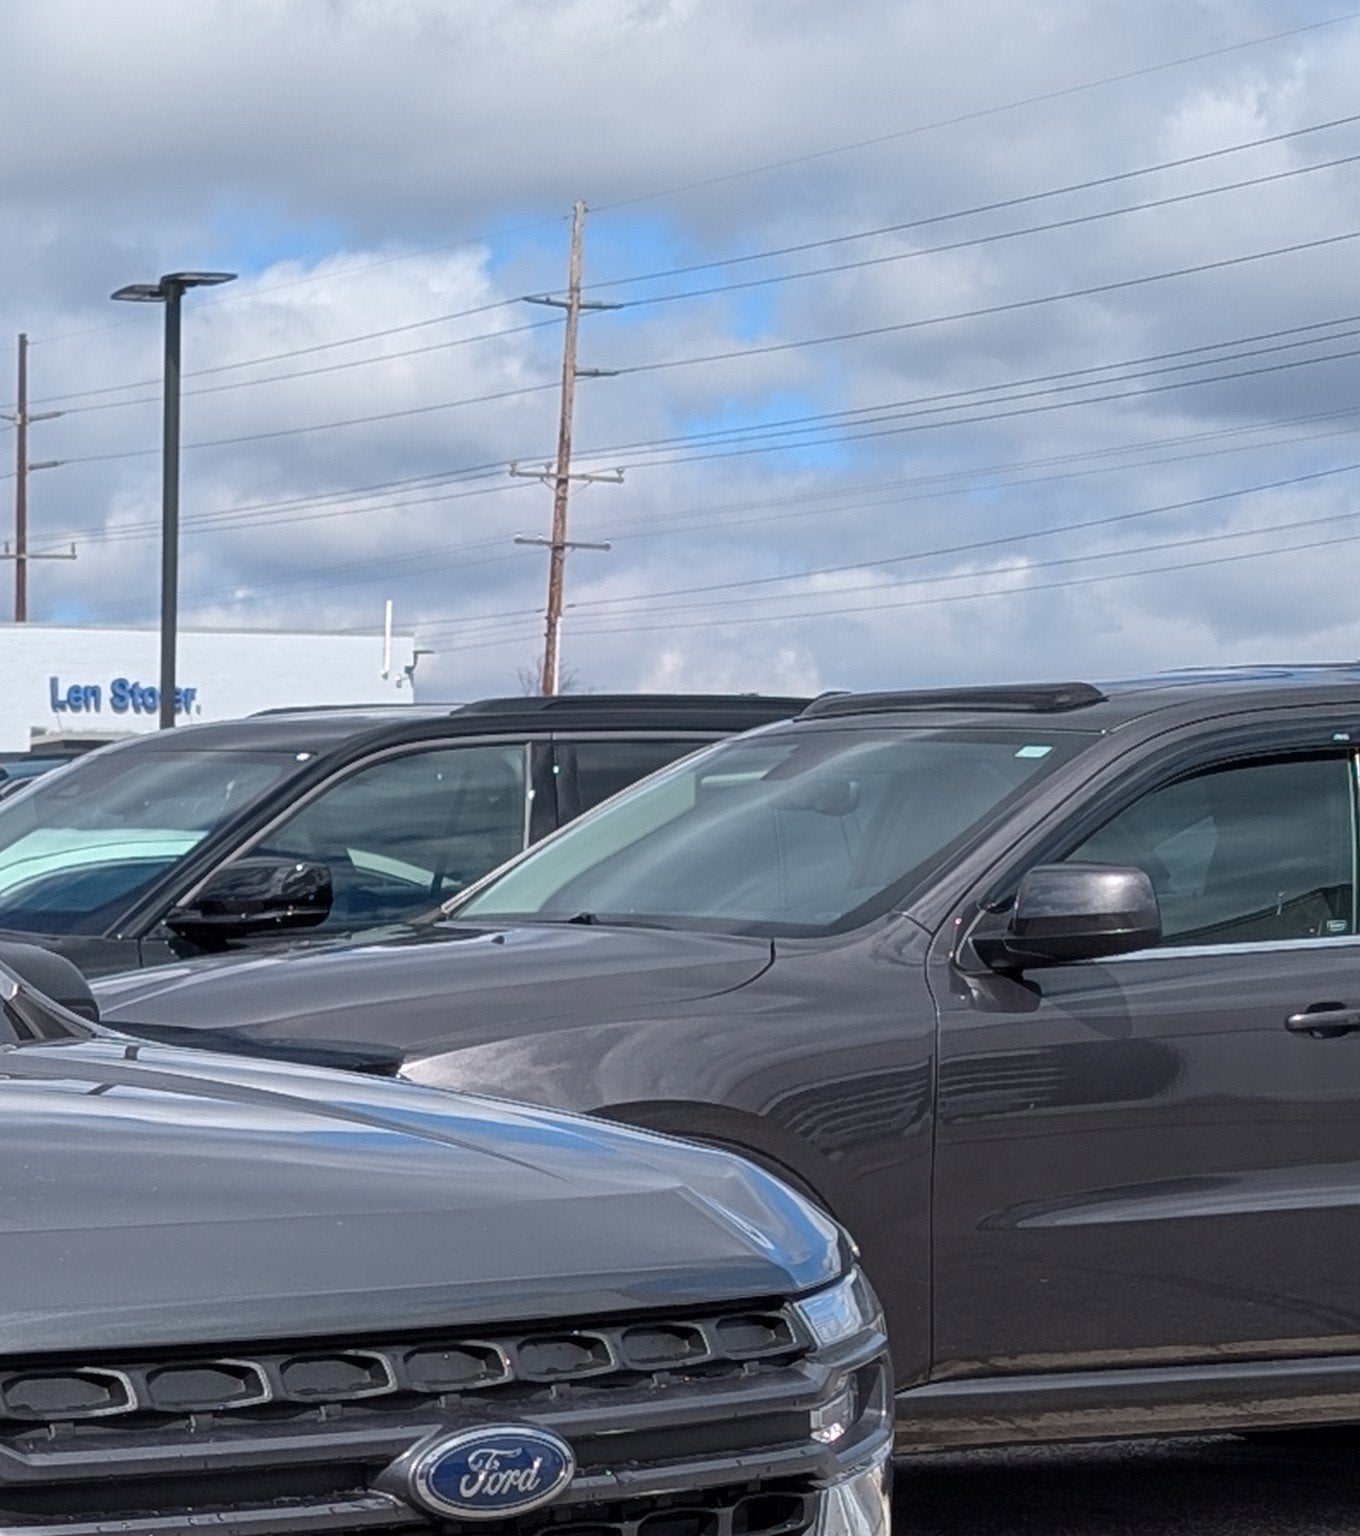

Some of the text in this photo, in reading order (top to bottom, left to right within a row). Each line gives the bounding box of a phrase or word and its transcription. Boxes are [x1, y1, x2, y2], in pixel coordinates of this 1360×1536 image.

[49, 676, 202, 716] Len Stoer.
[460, 1447, 543, 1498] Ford
